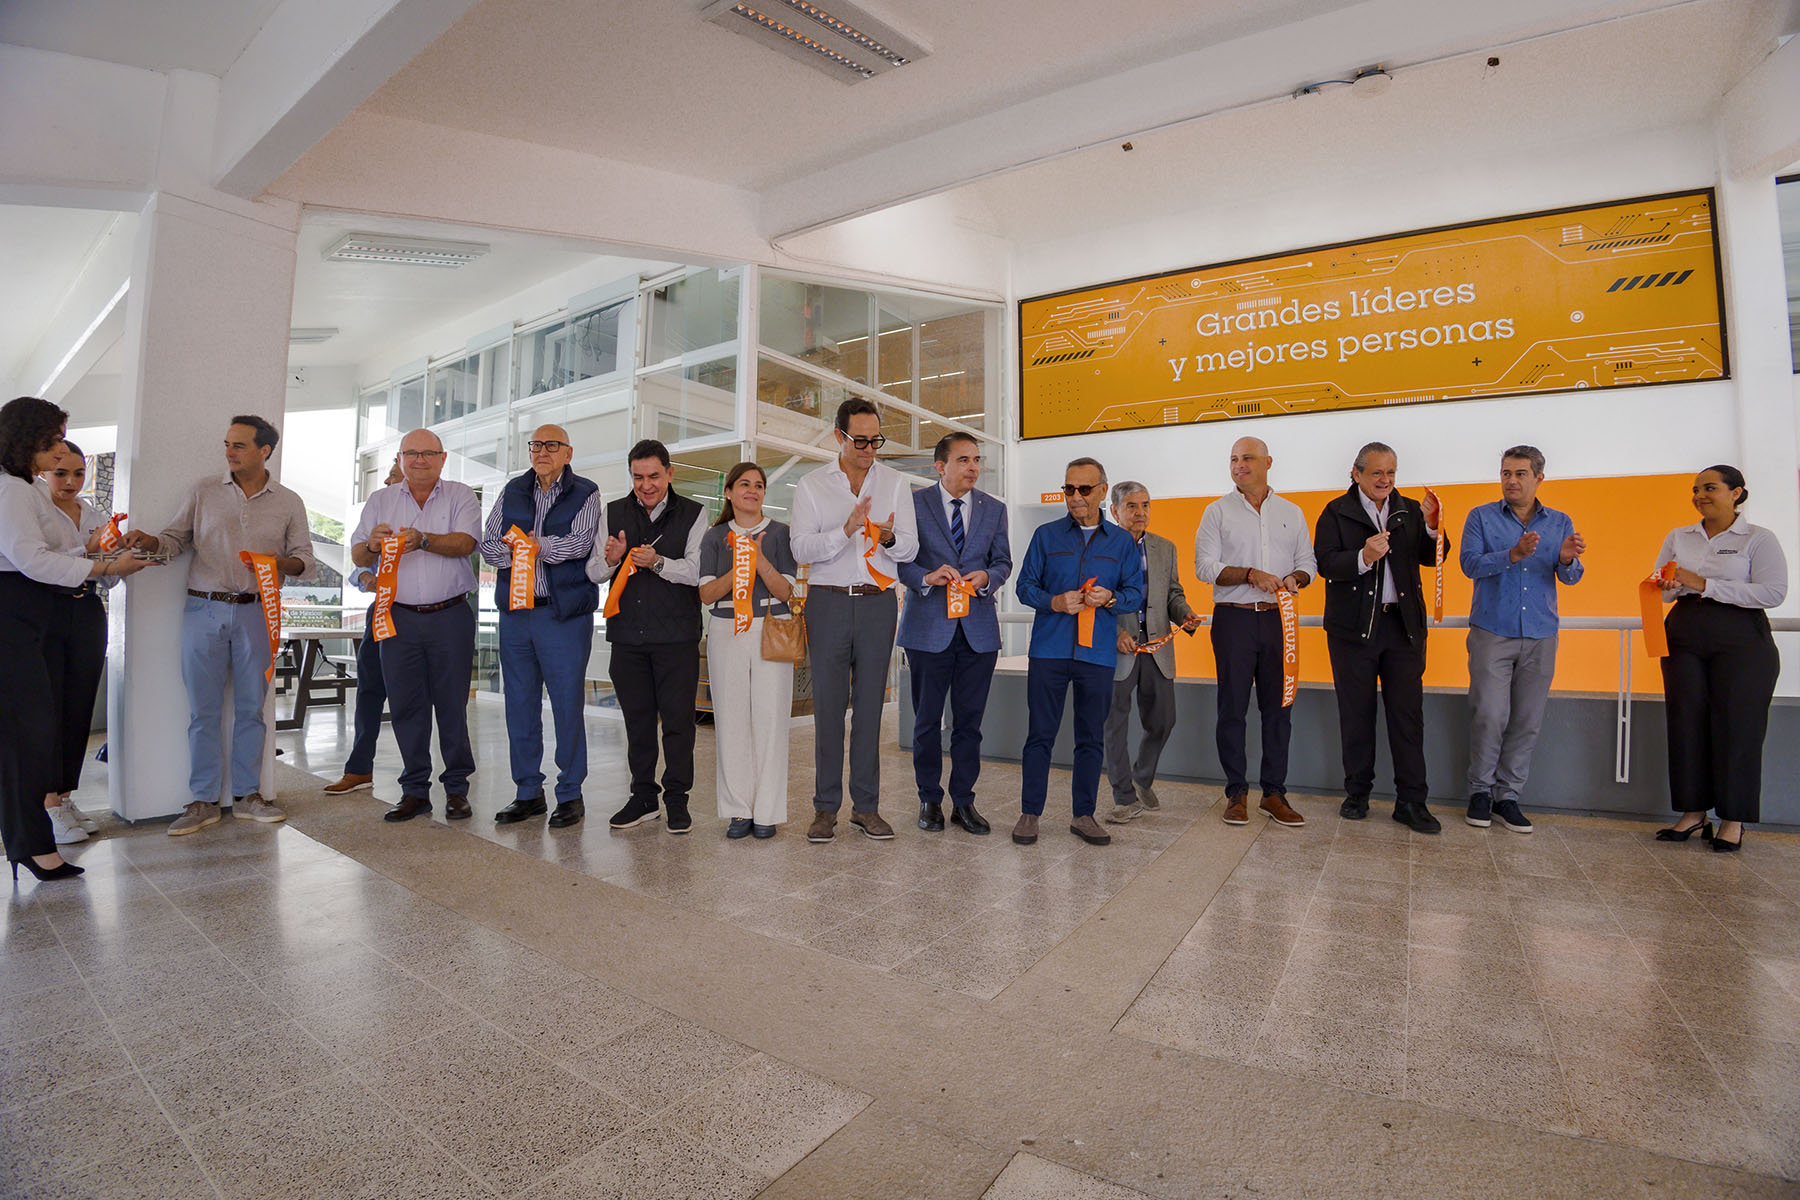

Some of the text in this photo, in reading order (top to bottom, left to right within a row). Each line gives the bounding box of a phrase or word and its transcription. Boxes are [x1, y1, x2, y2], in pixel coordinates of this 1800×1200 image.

[1196, 282, 1476, 337] Grandes líderes
[1168, 317, 1515, 382] y mejores personas
[1044, 494, 1061, 502] 2203
[256, 563, 280, 641] ANÁHUAC
[1278, 591, 1297, 664] ANÁHUAC
